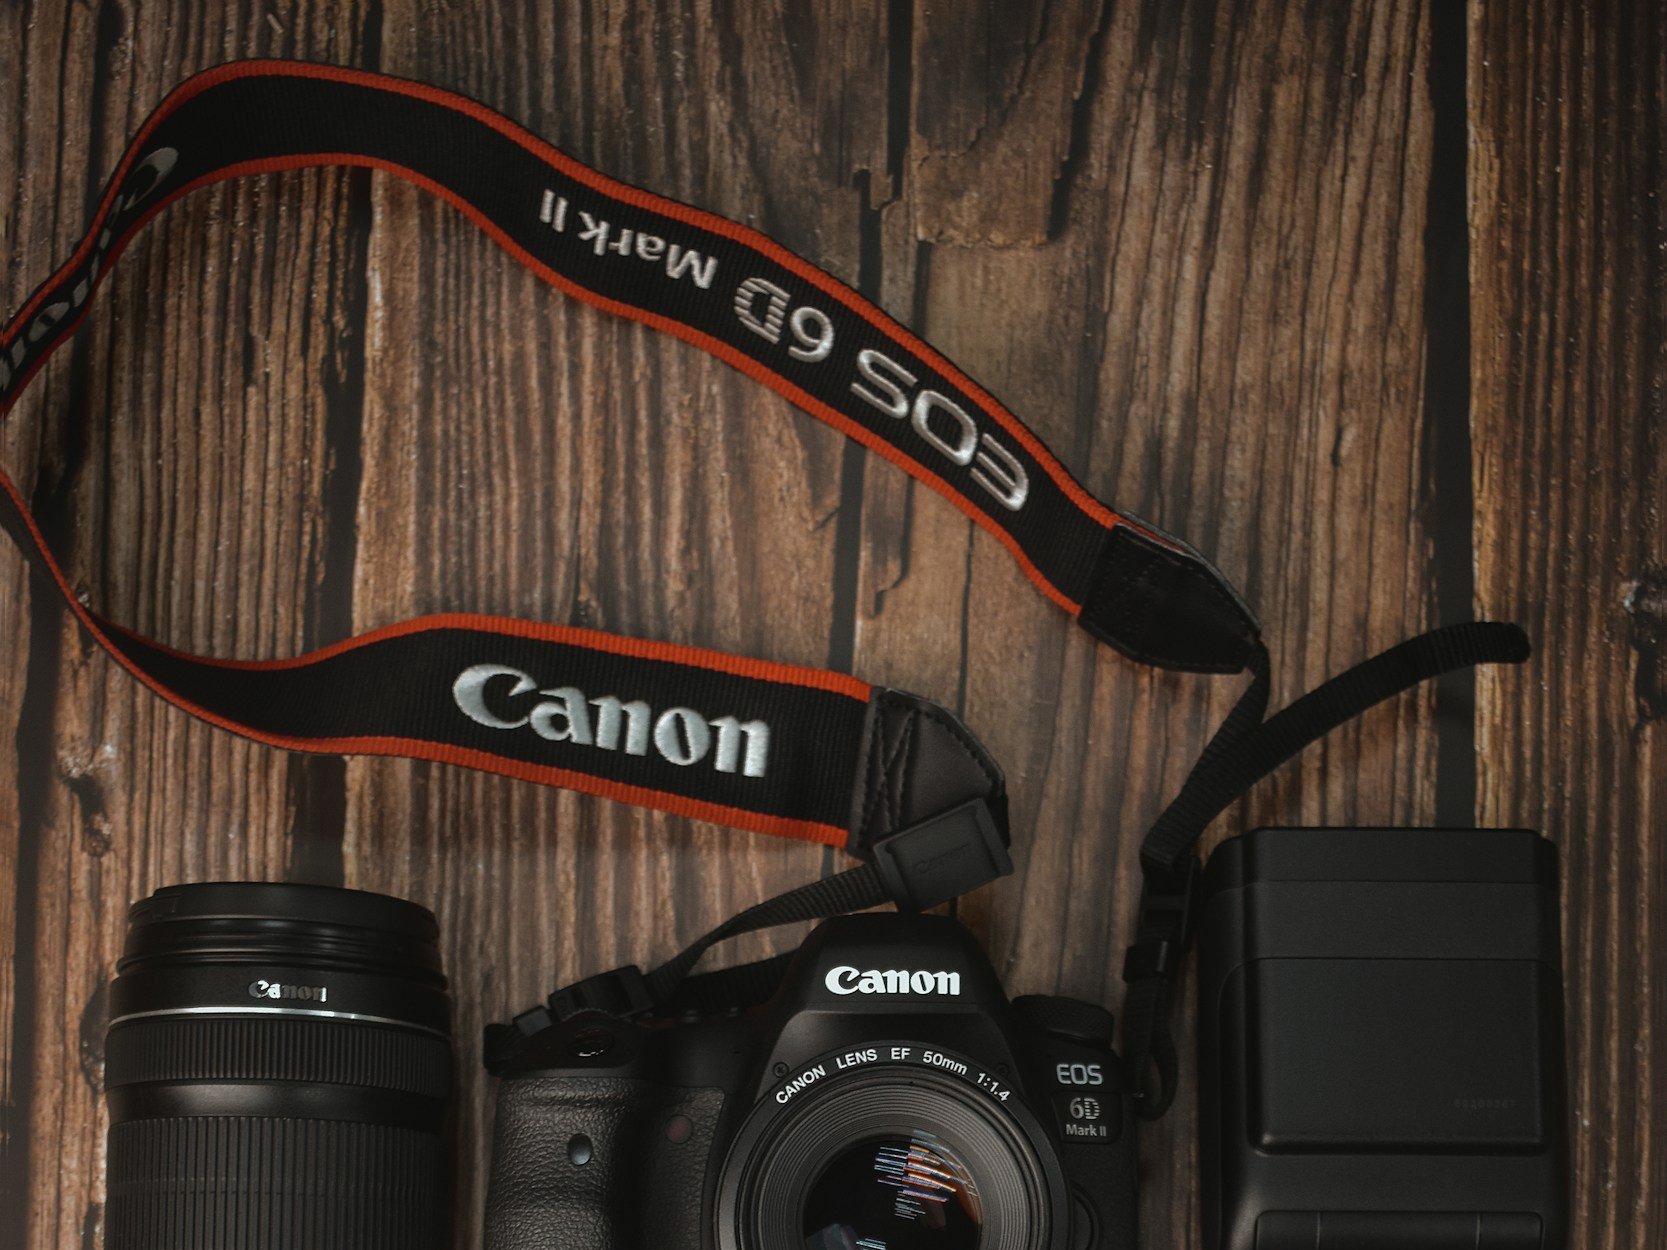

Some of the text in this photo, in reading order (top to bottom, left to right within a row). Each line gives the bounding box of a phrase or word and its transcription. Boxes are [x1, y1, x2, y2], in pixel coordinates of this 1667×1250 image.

[539, 188, 1029, 512] EOS 6D Mark II
[452, 663, 770, 778] Canon
[248, 980, 327, 1002] Canon
[825, 966, 960, 996] Canon
[775, 1047, 1011, 1104] CANON LENS EF 50mm 1:1.4
[1056, 1063, 1104, 1085] EOS
[1069, 1097, 1101, 1120] 6D
[1065, 1123, 1107, 1137] Mark II
